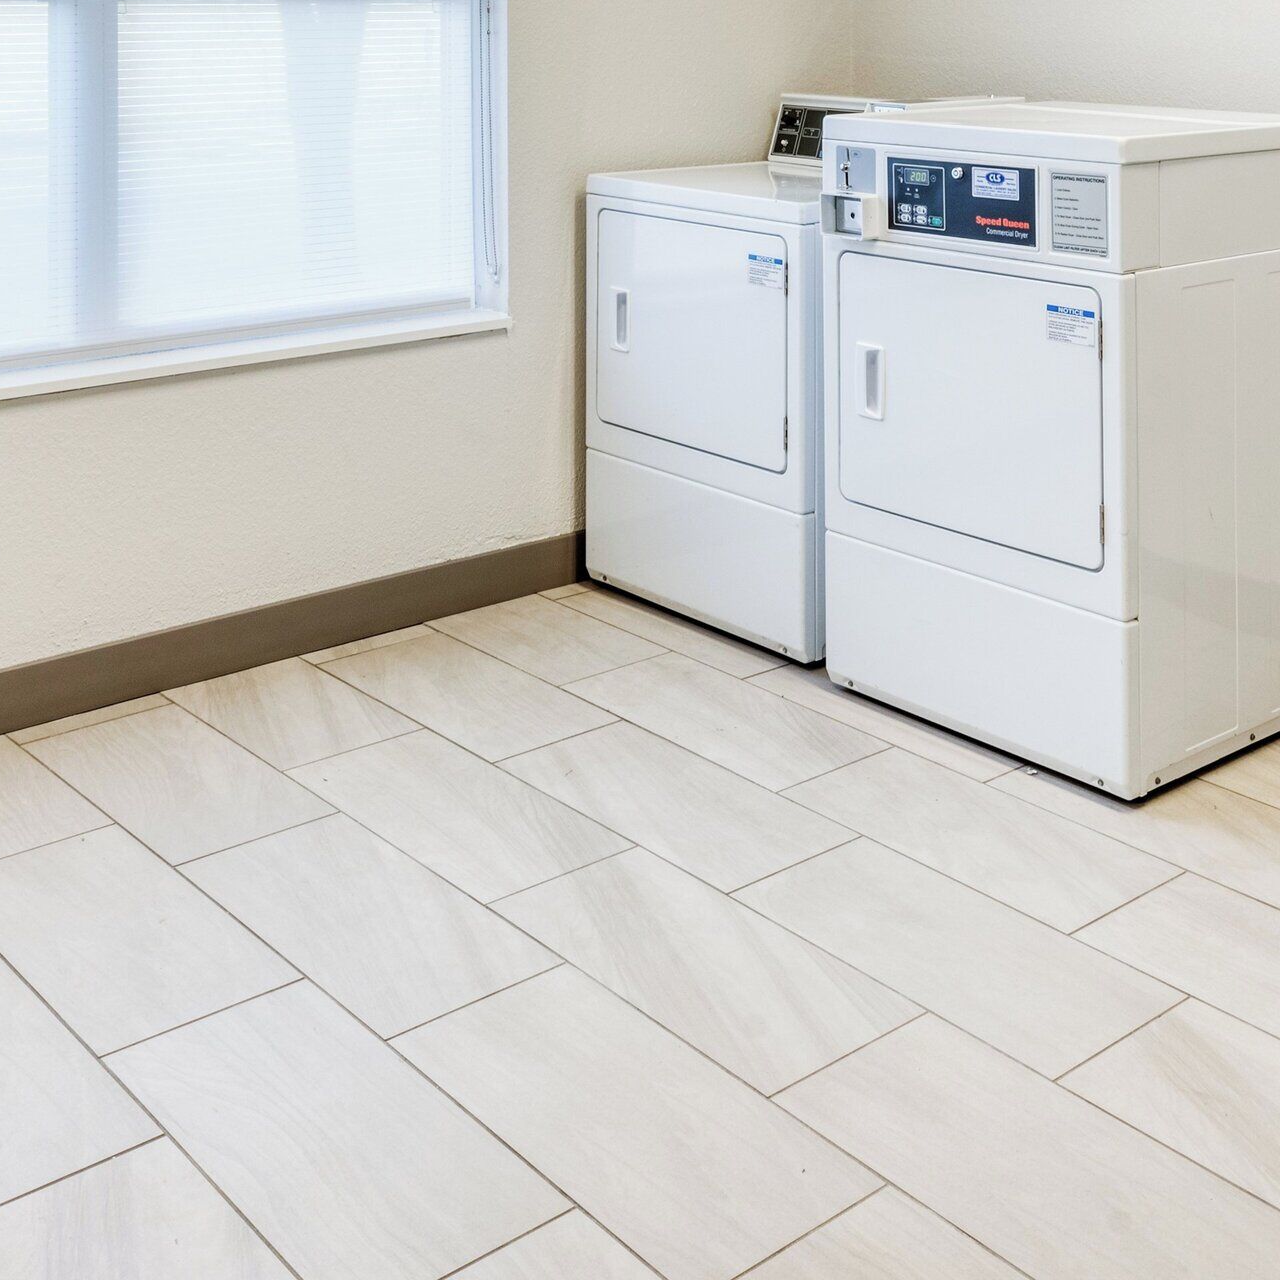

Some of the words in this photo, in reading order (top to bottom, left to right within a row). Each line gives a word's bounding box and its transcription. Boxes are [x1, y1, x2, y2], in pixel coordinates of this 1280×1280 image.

[989, 173, 1002, 182] CLS
[976, 216, 1001, 226] Speed
[1003, 218, 1030, 229] Queen
[986, 227, 1014, 237] Commercial
[1014, 231, 1029, 239] Dryer
[1058, 306, 1084, 317] NOTICE
